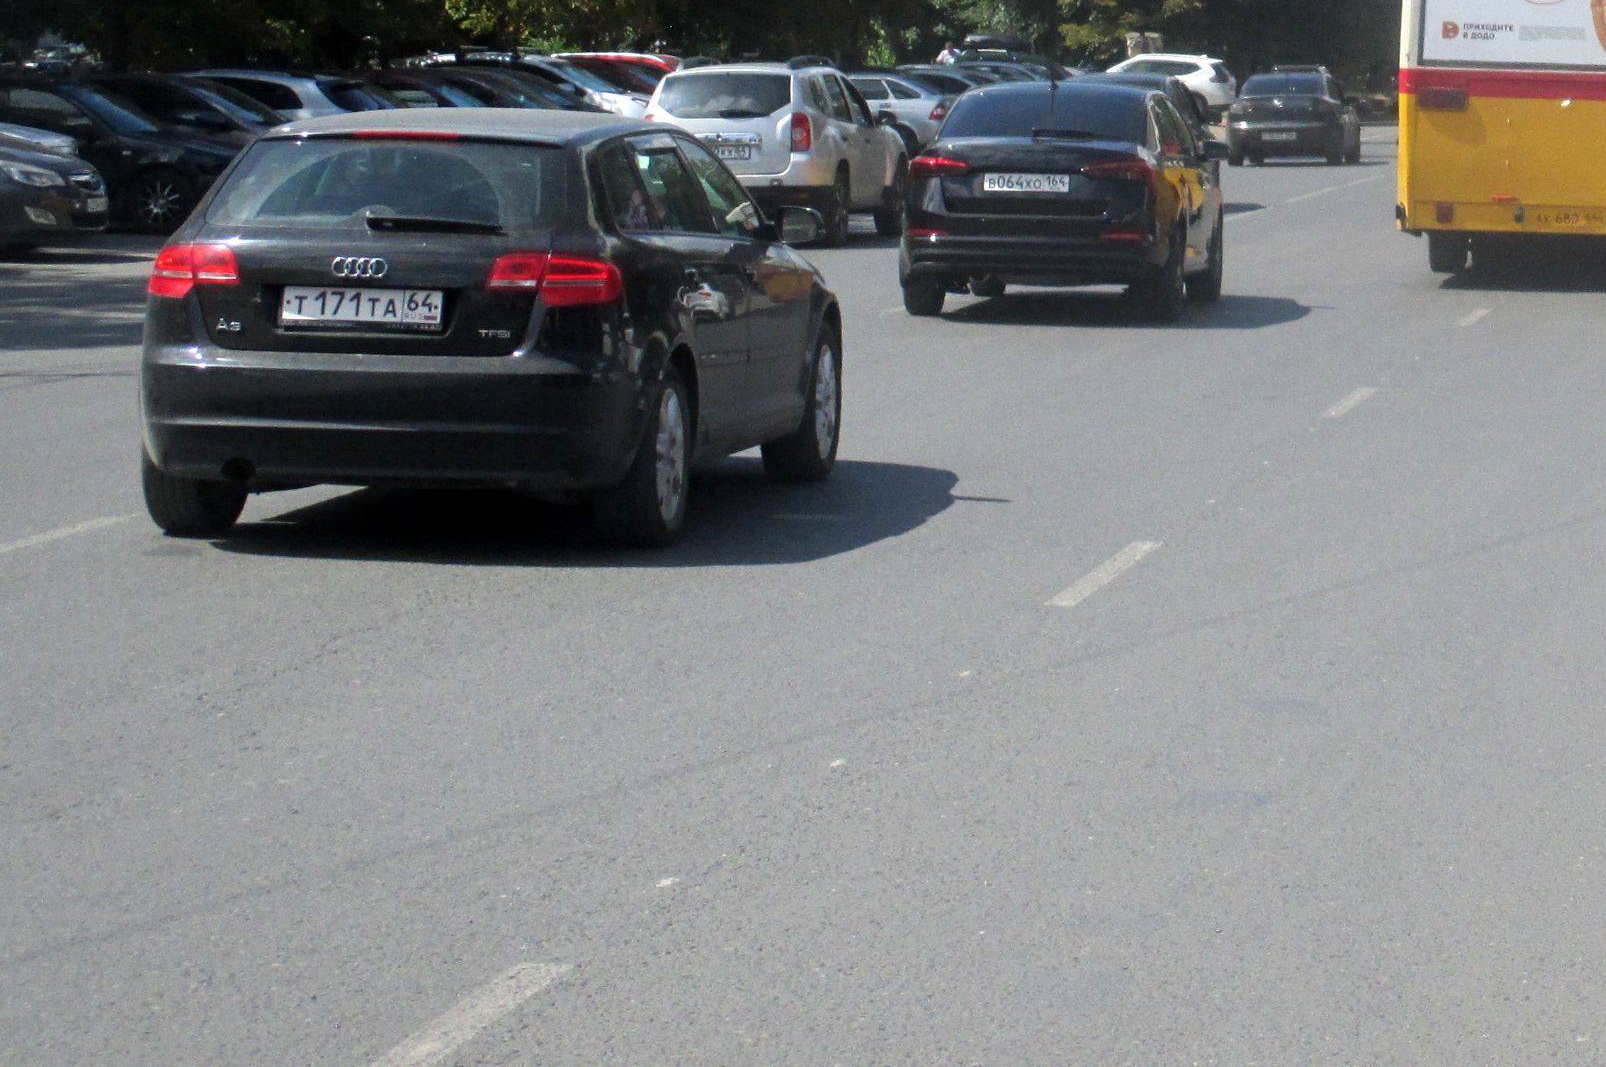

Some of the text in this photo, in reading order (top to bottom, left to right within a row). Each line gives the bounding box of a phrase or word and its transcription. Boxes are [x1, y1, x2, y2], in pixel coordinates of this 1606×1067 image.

[294, 291, 433, 317] Т171ТА 64
[215, 317, 242, 331] A3
